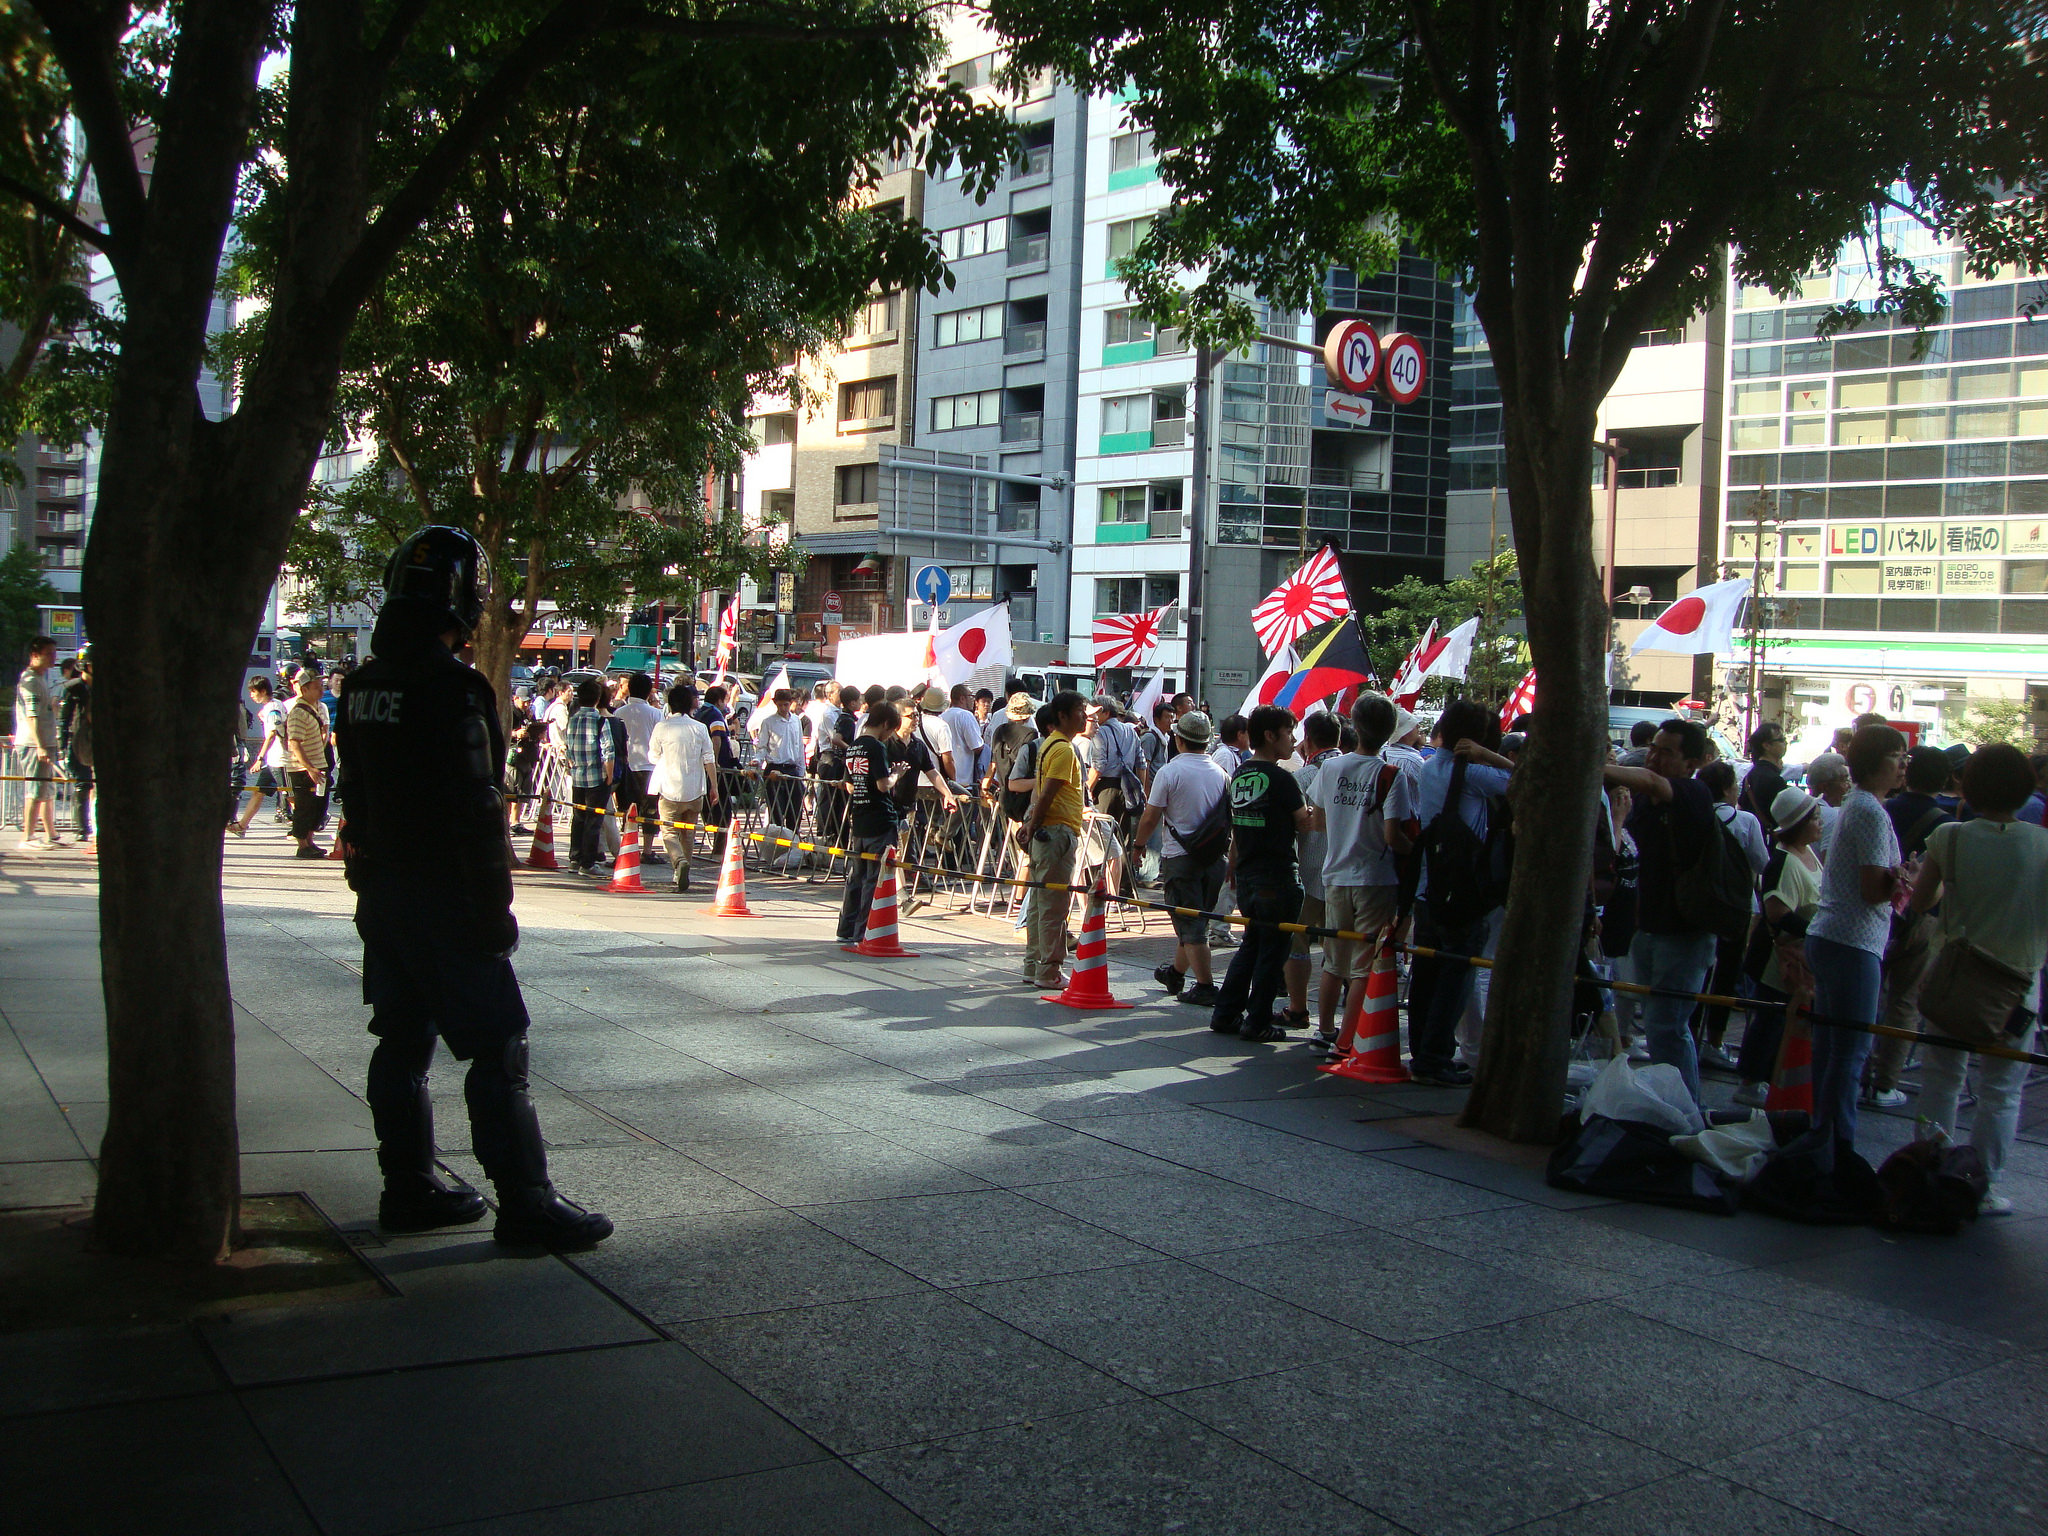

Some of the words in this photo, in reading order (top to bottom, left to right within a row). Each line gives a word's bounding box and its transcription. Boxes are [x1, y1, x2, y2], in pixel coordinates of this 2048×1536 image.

[1392, 354, 1417, 385] 40
[1946, 571, 1995, 580] 888-708
[1956, 563, 1979, 571] 0120
[348, 691, 404, 724] POLICE
